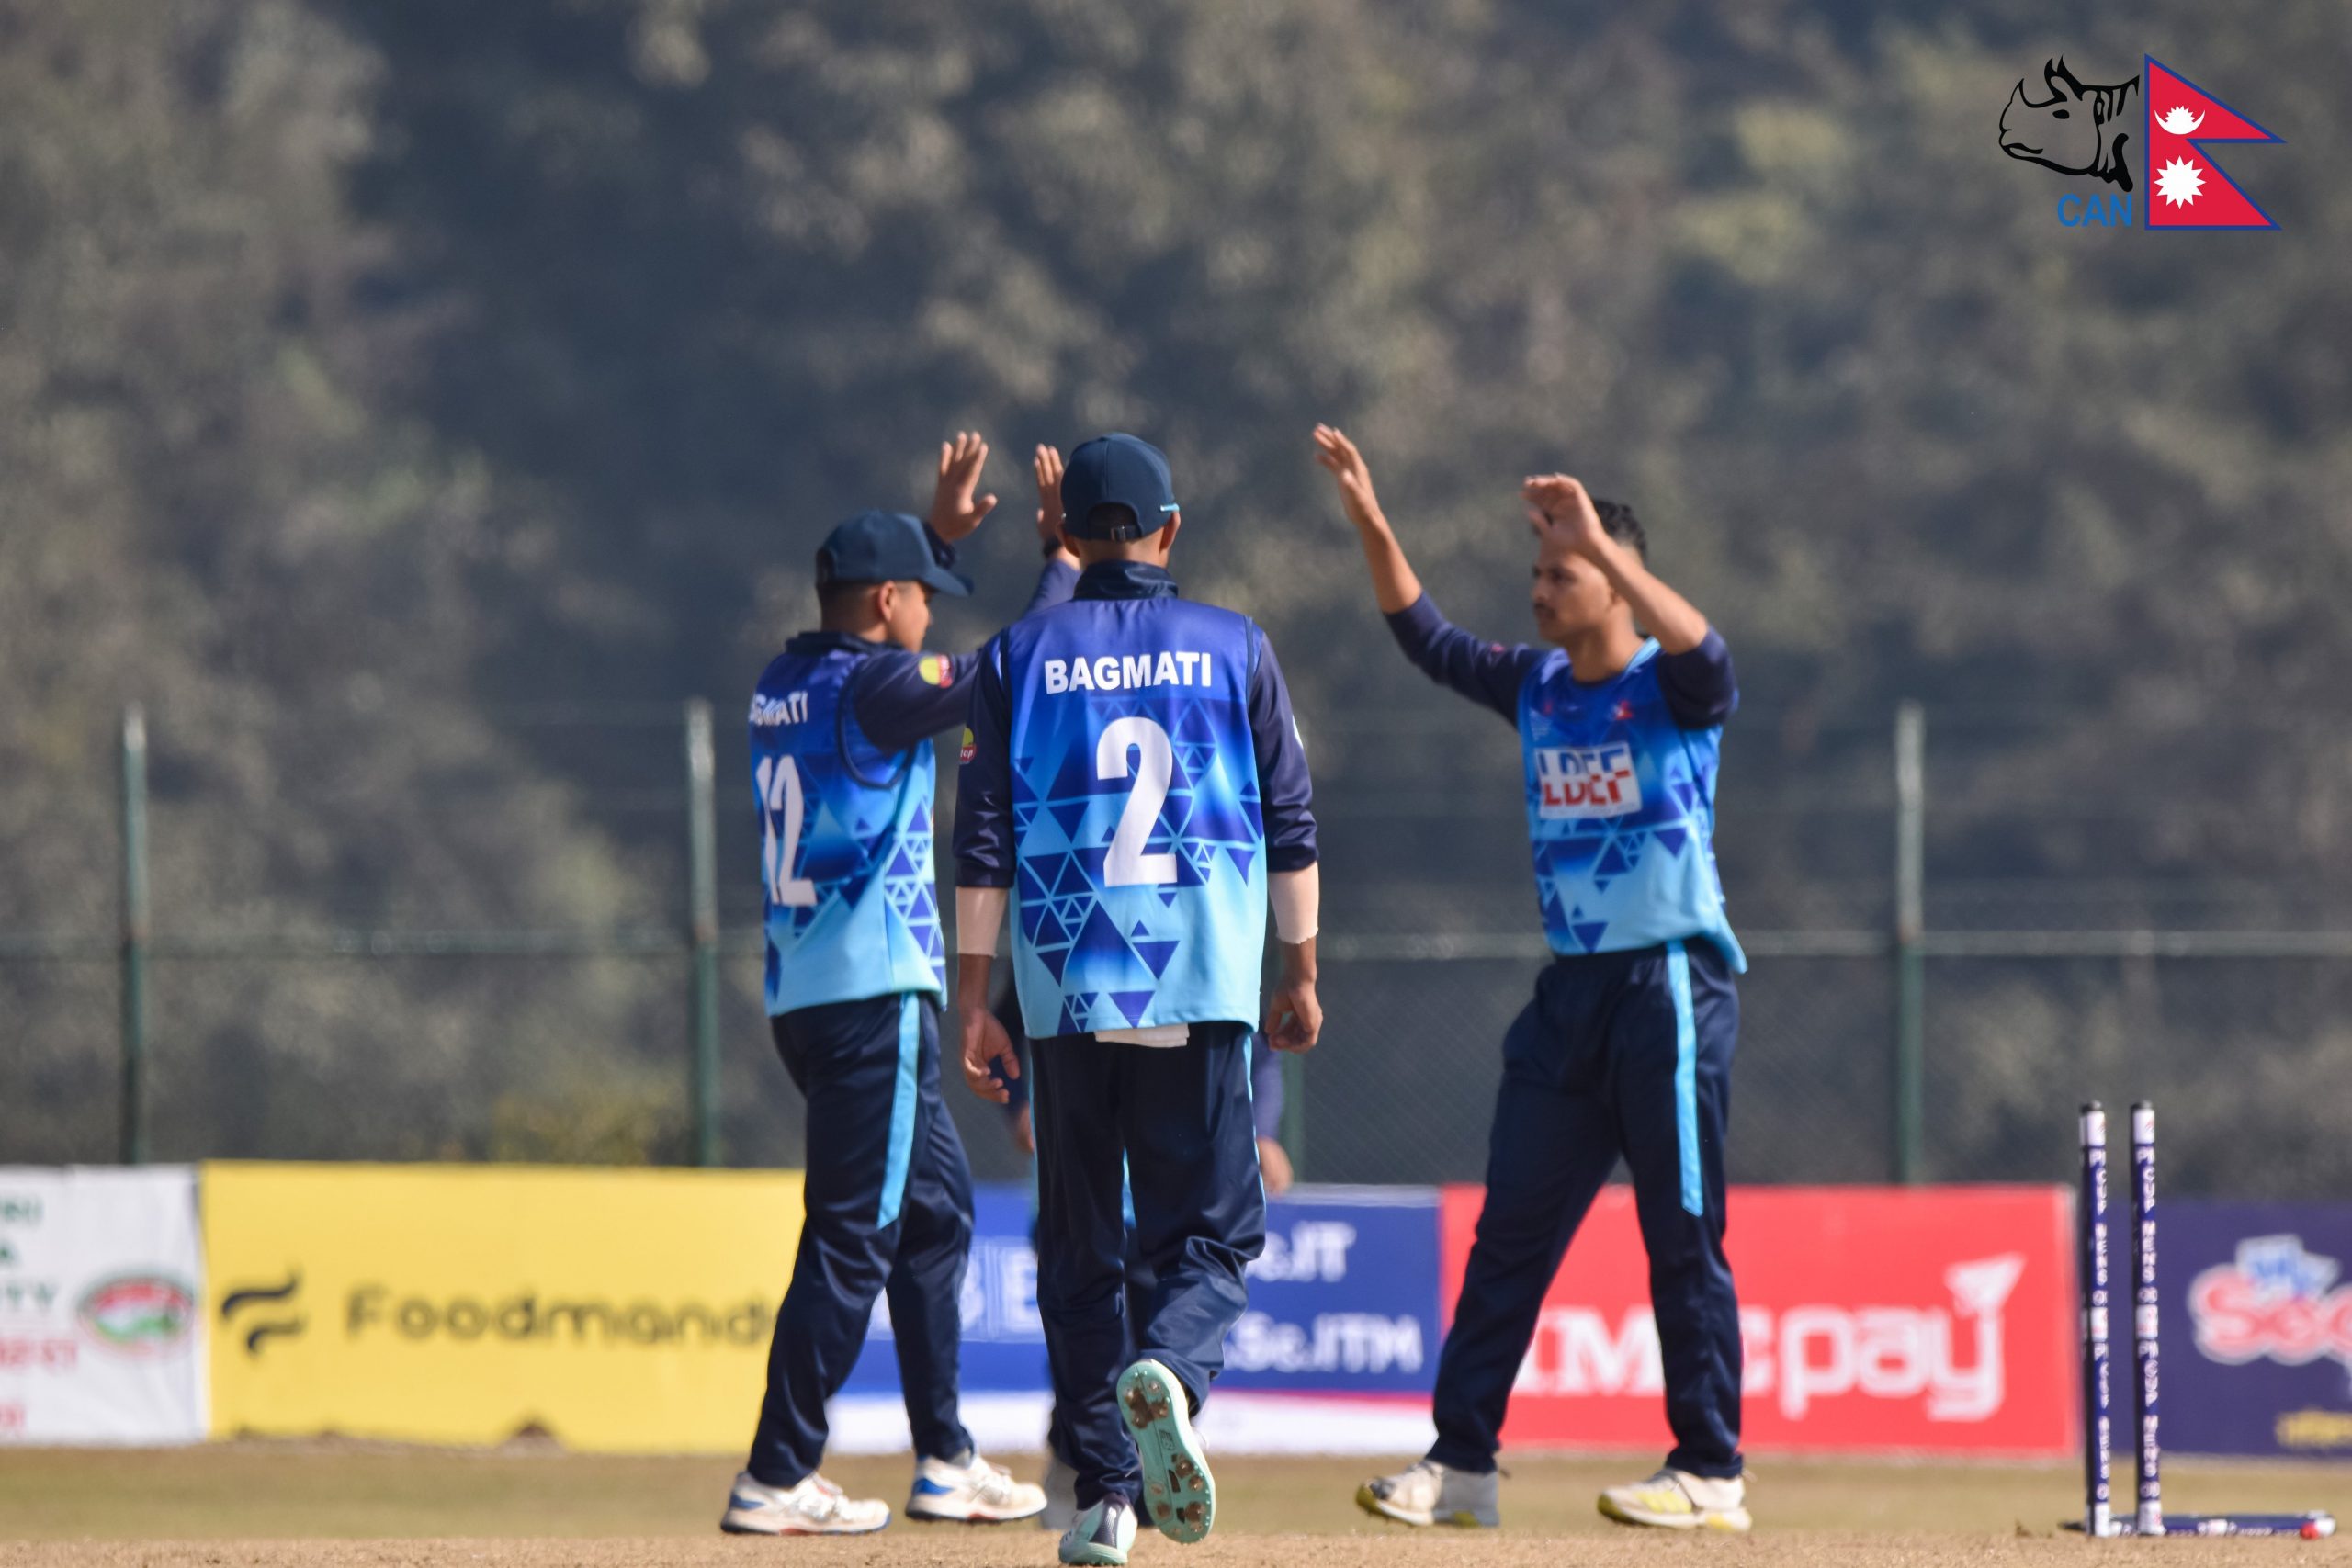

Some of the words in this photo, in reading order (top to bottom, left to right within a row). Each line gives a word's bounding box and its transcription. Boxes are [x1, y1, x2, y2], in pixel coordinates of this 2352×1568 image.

[1044, 650, 1212, 694] BAGMATI
[755, 755, 819, 907] 12
[1096, 716, 1178, 888] 2
[345, 1288, 774, 1345] Foodmand
